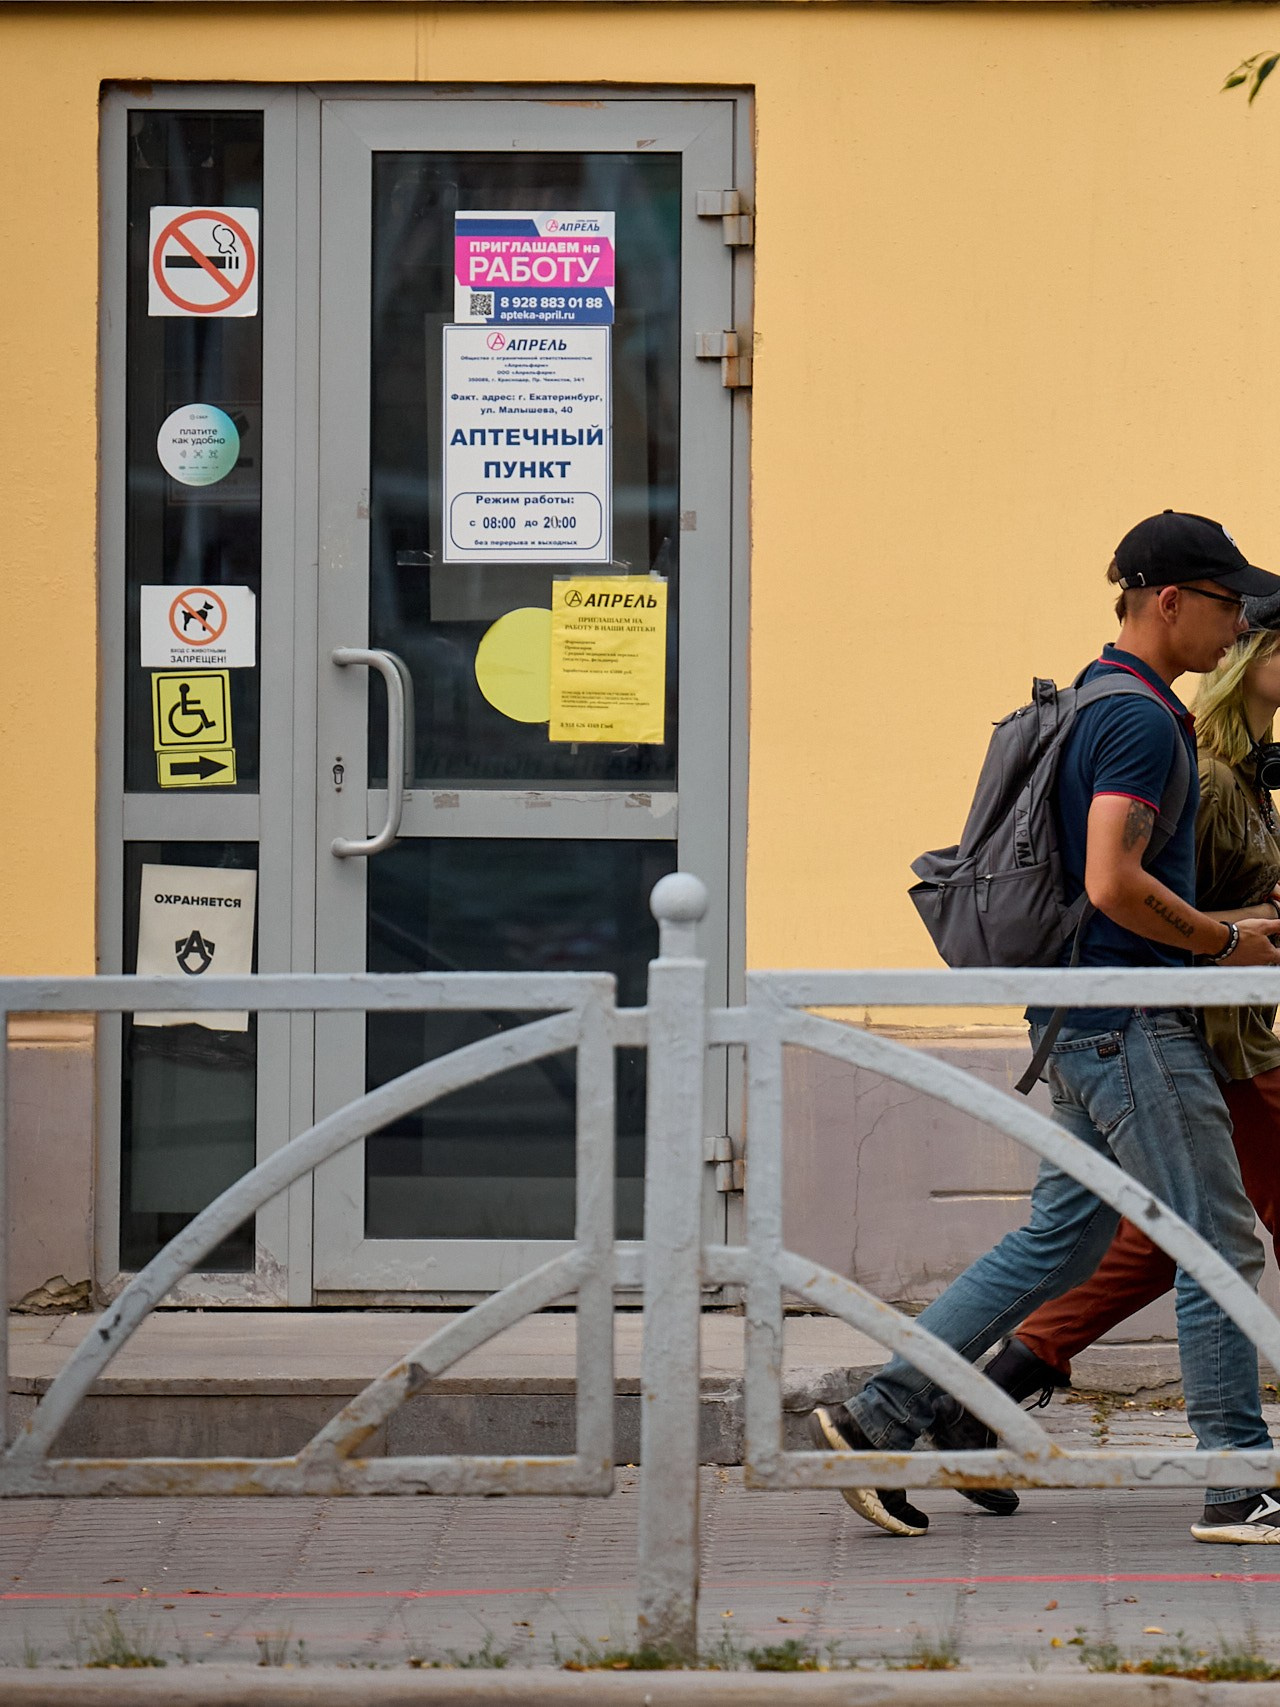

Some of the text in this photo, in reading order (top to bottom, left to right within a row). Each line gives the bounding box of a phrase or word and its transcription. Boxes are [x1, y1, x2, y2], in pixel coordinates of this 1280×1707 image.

[560, 223, 600, 231] АПРЕЛЬ
[470, 241, 600, 253] ПРИГЛАШАЕМ на
[469, 257, 599, 282] РАБОТУ
[500, 297, 603, 308] 8 928 883 01 88
[500, 310, 575, 321] apteka-april.ru
[506, 339, 567, 351] АПРЕЛЬ
[530, 393, 603, 402] Екатеринбург,
[499, 406, 557, 414] Малышева,
[450, 424, 603, 446] АПТЕЧНЫЙ
[191, 436, 225, 446] удобно
[484, 461, 571, 478] ПУНКТ
[476, 495, 574, 506] Режим работы:
[483, 517, 516, 529] 08:00
[584, 594, 657, 608] АПРЕЛЬ
[171, 656, 226, 664] ЗАПРЕЩЕН!
[155, 894, 242, 908] ОХРАНЯЕТСЯ
